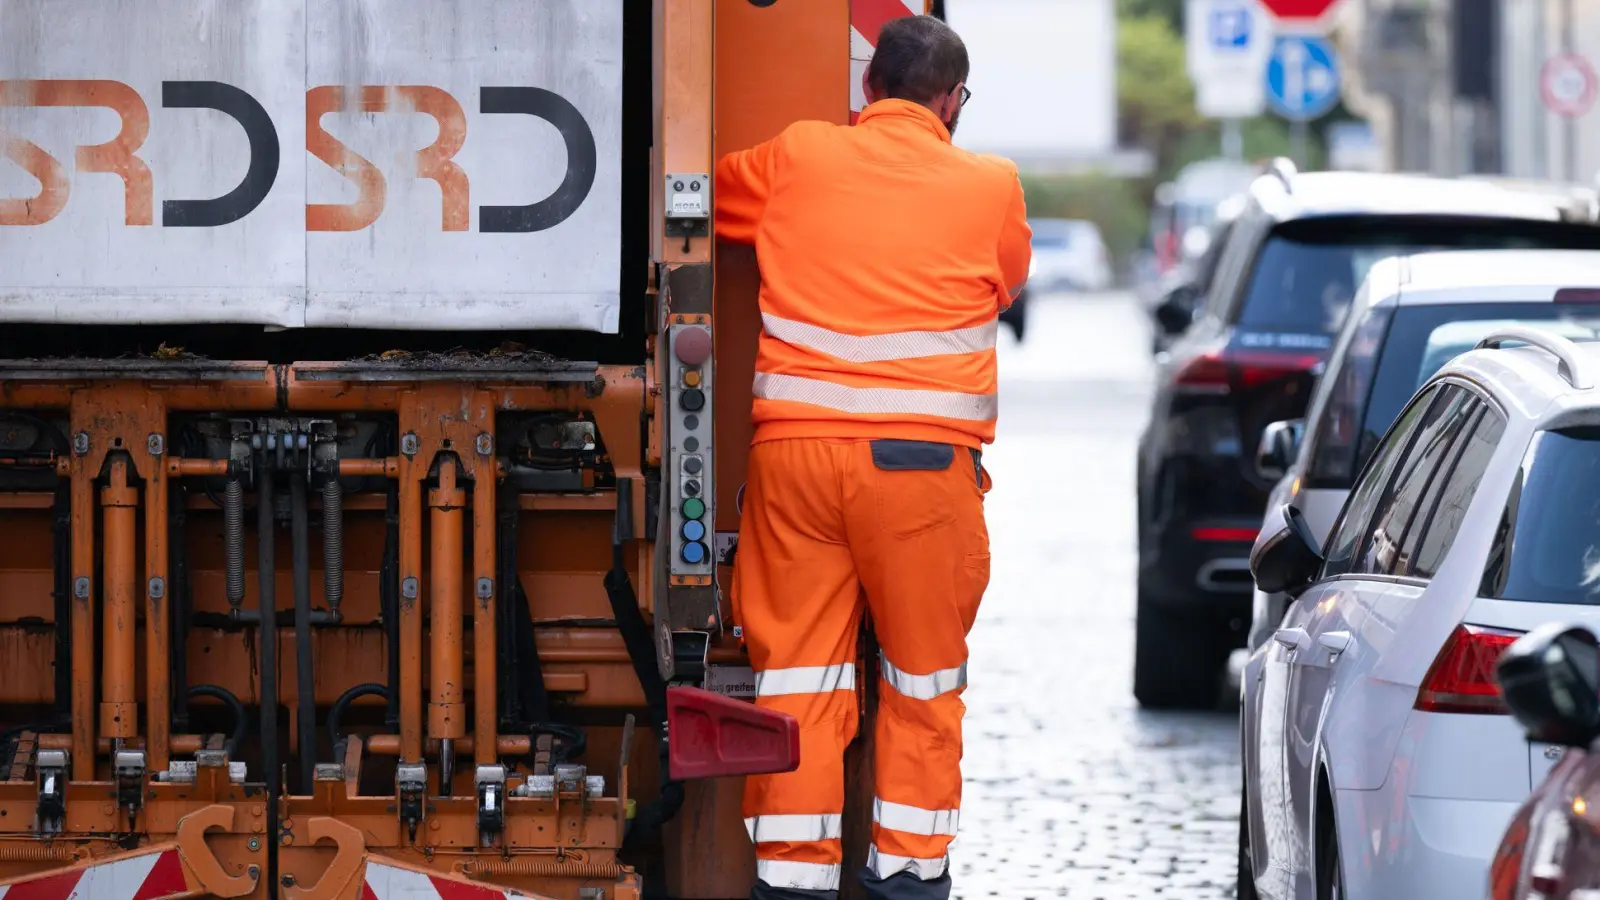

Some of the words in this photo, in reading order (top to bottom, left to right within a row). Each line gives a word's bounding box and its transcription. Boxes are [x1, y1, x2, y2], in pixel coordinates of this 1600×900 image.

[0, 80, 280, 227] SRD
[305, 85, 597, 232] SRD
[725, 682, 756, 693] greifen
